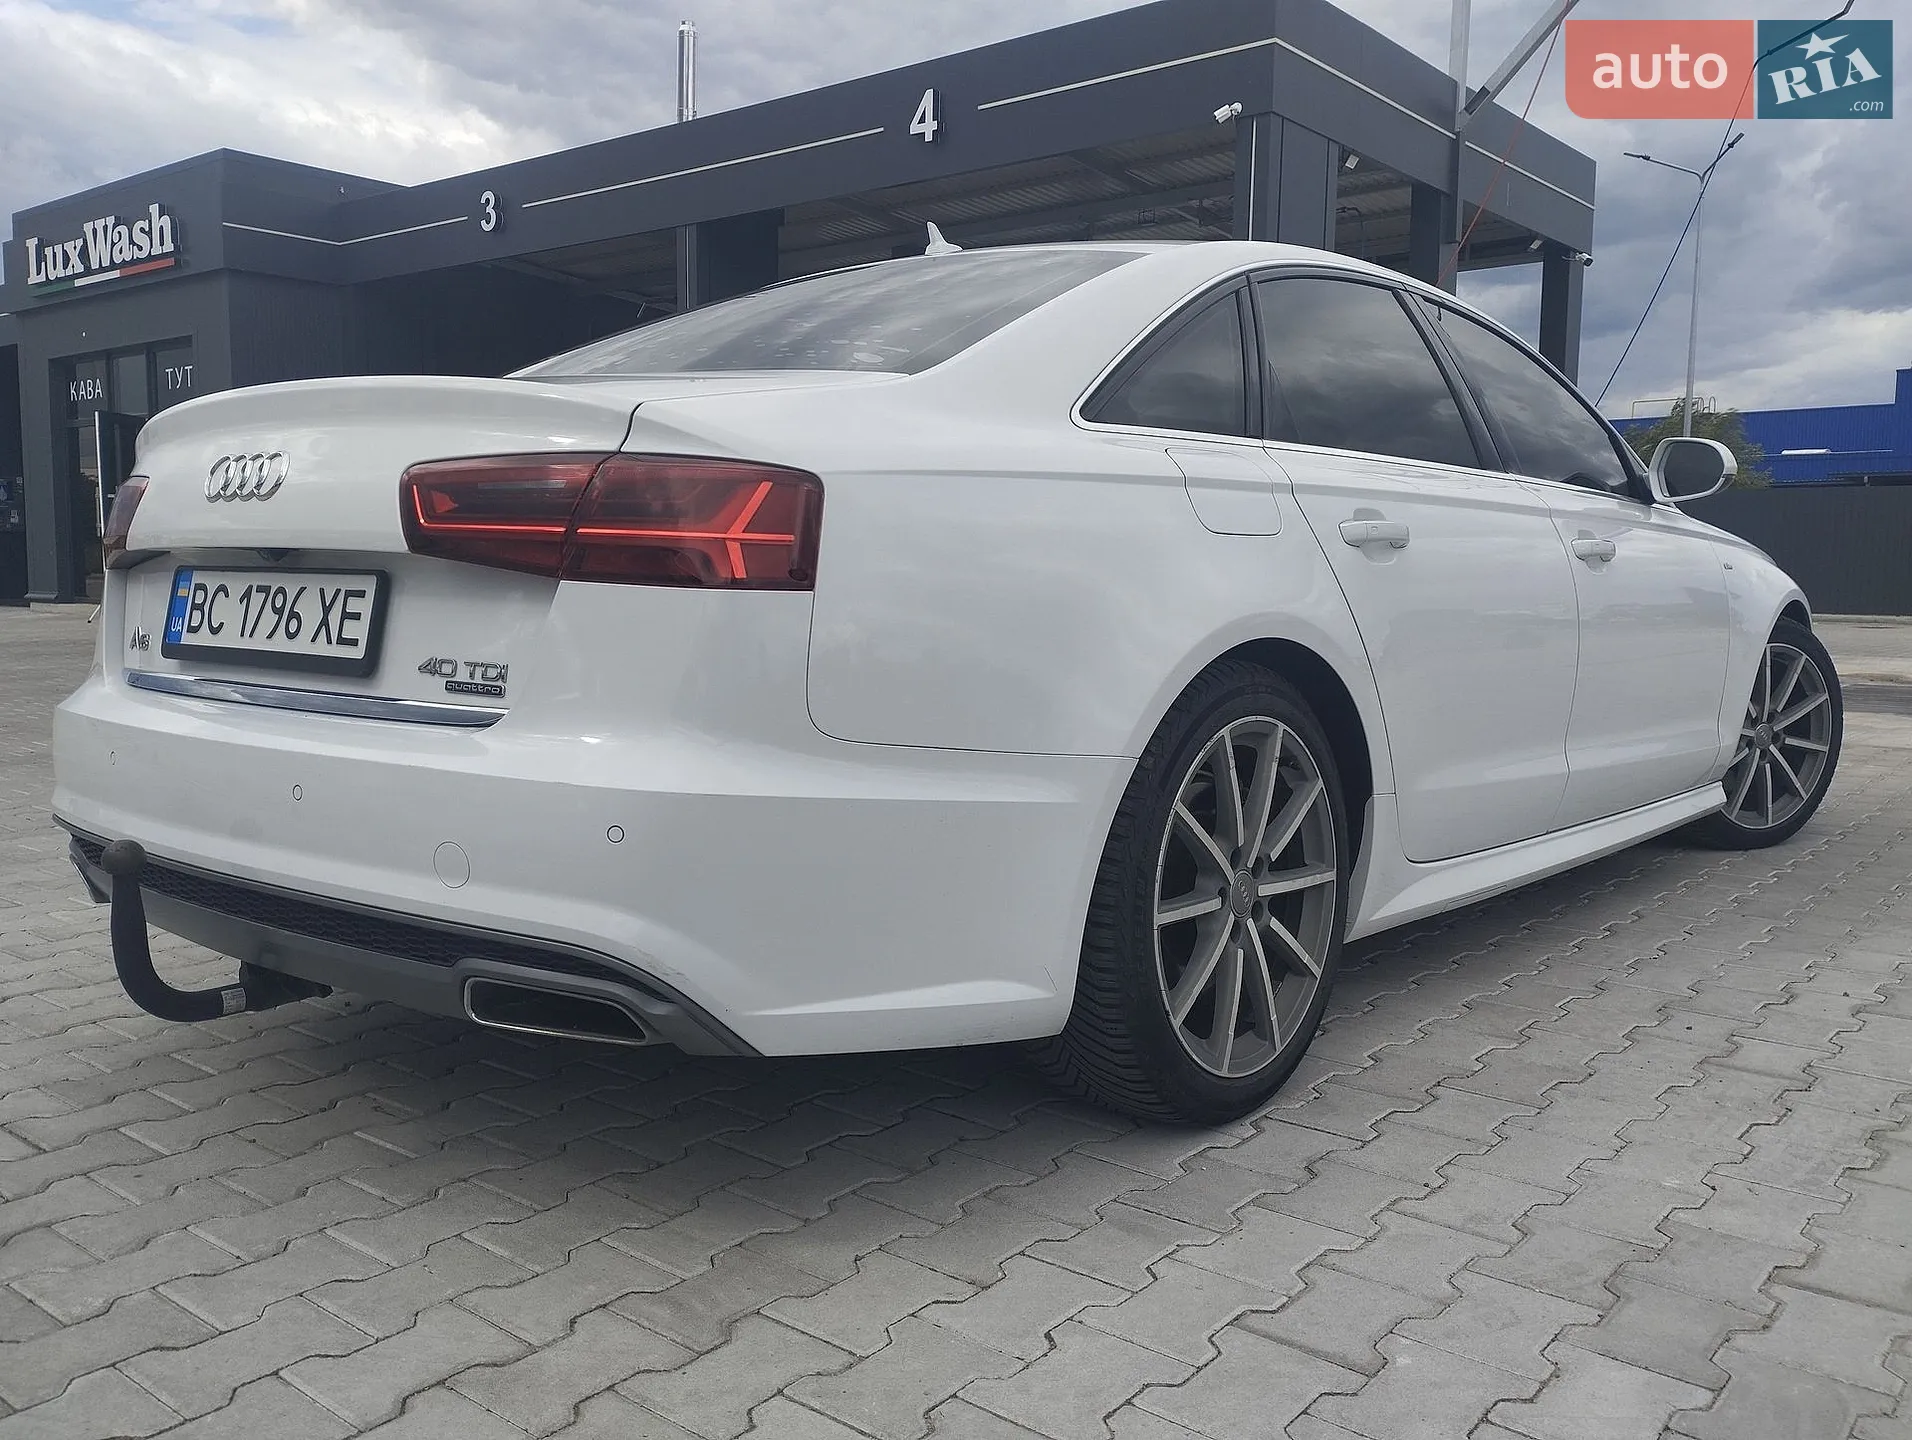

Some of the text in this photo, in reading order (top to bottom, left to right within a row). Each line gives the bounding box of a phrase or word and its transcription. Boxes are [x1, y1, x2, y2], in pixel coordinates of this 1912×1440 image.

[908, 88, 939, 143] 4
[479, 190, 498, 232] 3
[69, 365, 193, 402] КАВА ТУТ
[171, 616, 183, 633] UA
[186, 582, 368, 648] BC 1796 XE
[417, 656, 509, 684] 40 TDI
[446, 681, 502, 695] quattro
